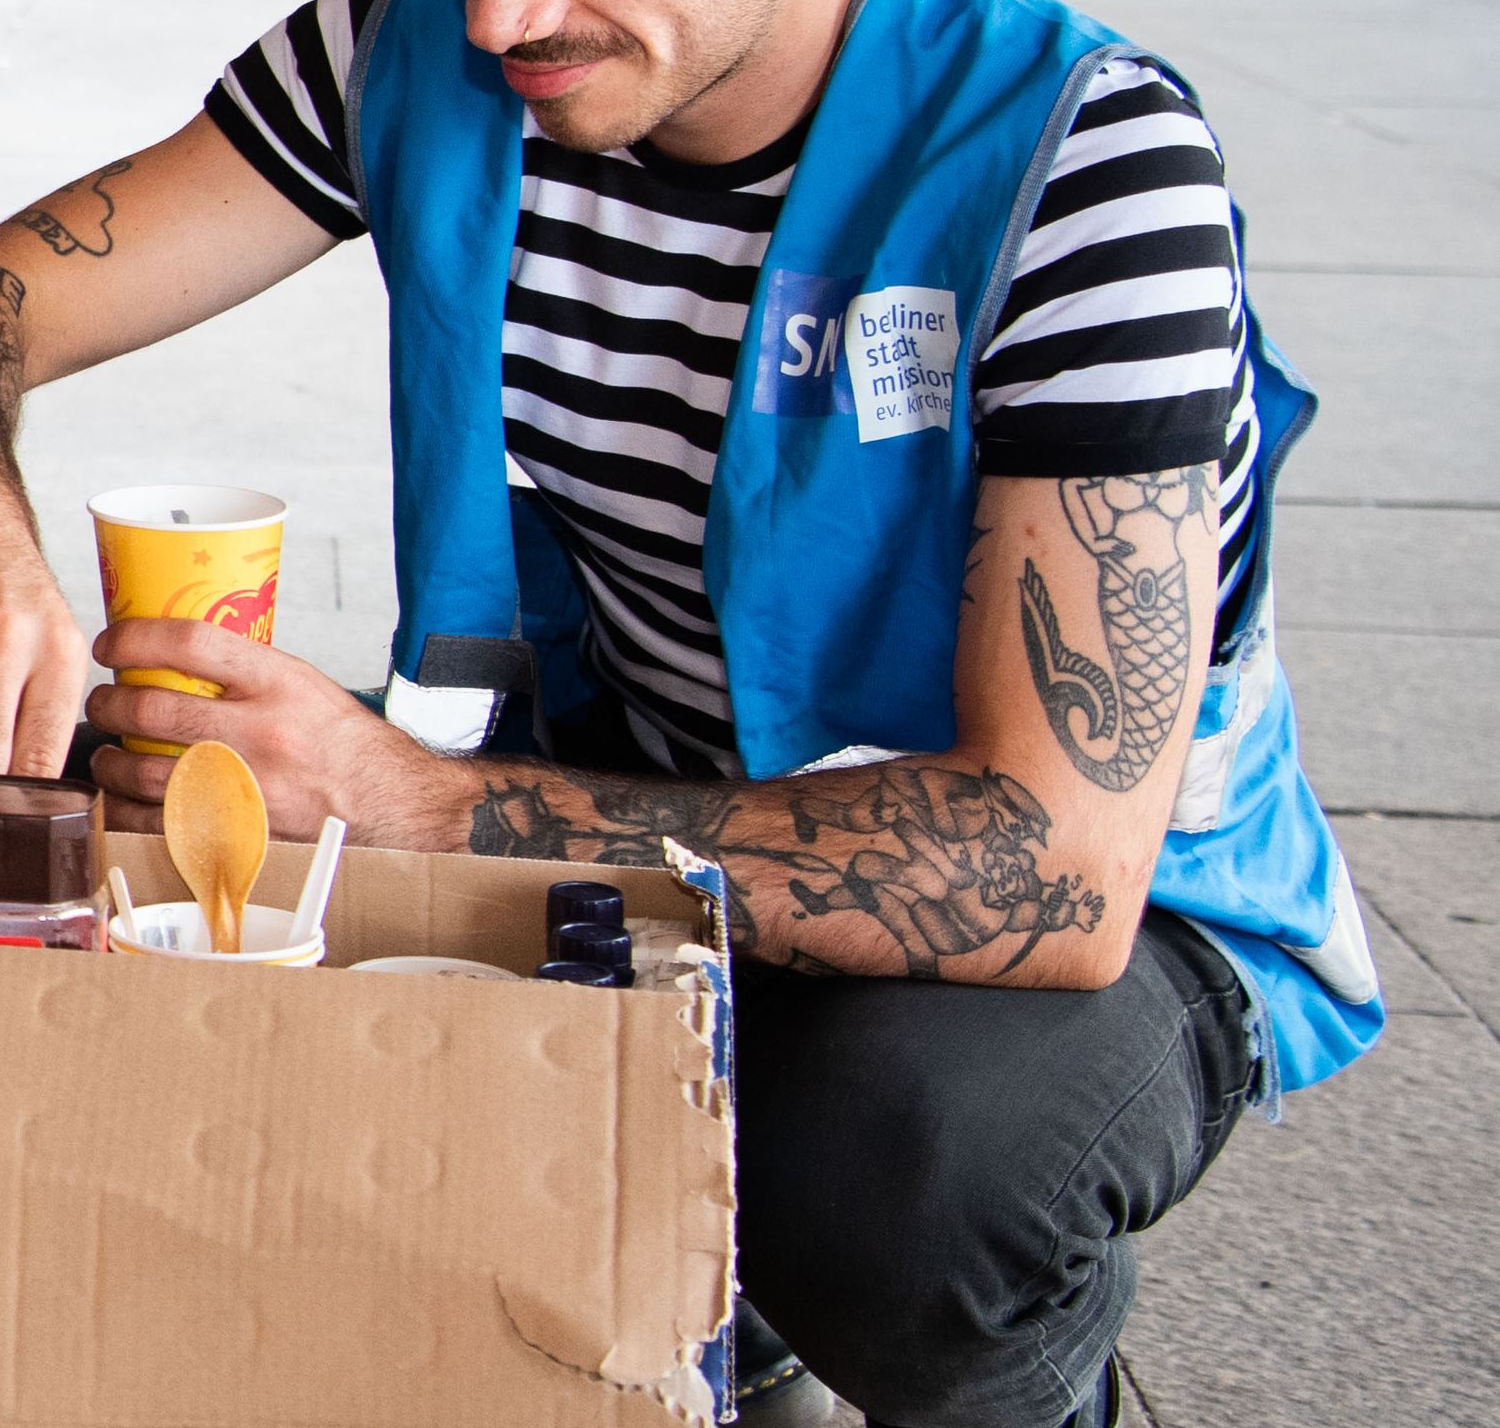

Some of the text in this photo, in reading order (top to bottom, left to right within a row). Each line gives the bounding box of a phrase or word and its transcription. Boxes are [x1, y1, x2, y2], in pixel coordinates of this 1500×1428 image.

[860, 303, 945, 338] beliner
[866, 333, 921, 367] stadt
[873, 363, 953, 396] mission
[876, 392, 951, 421] ev. kirche
